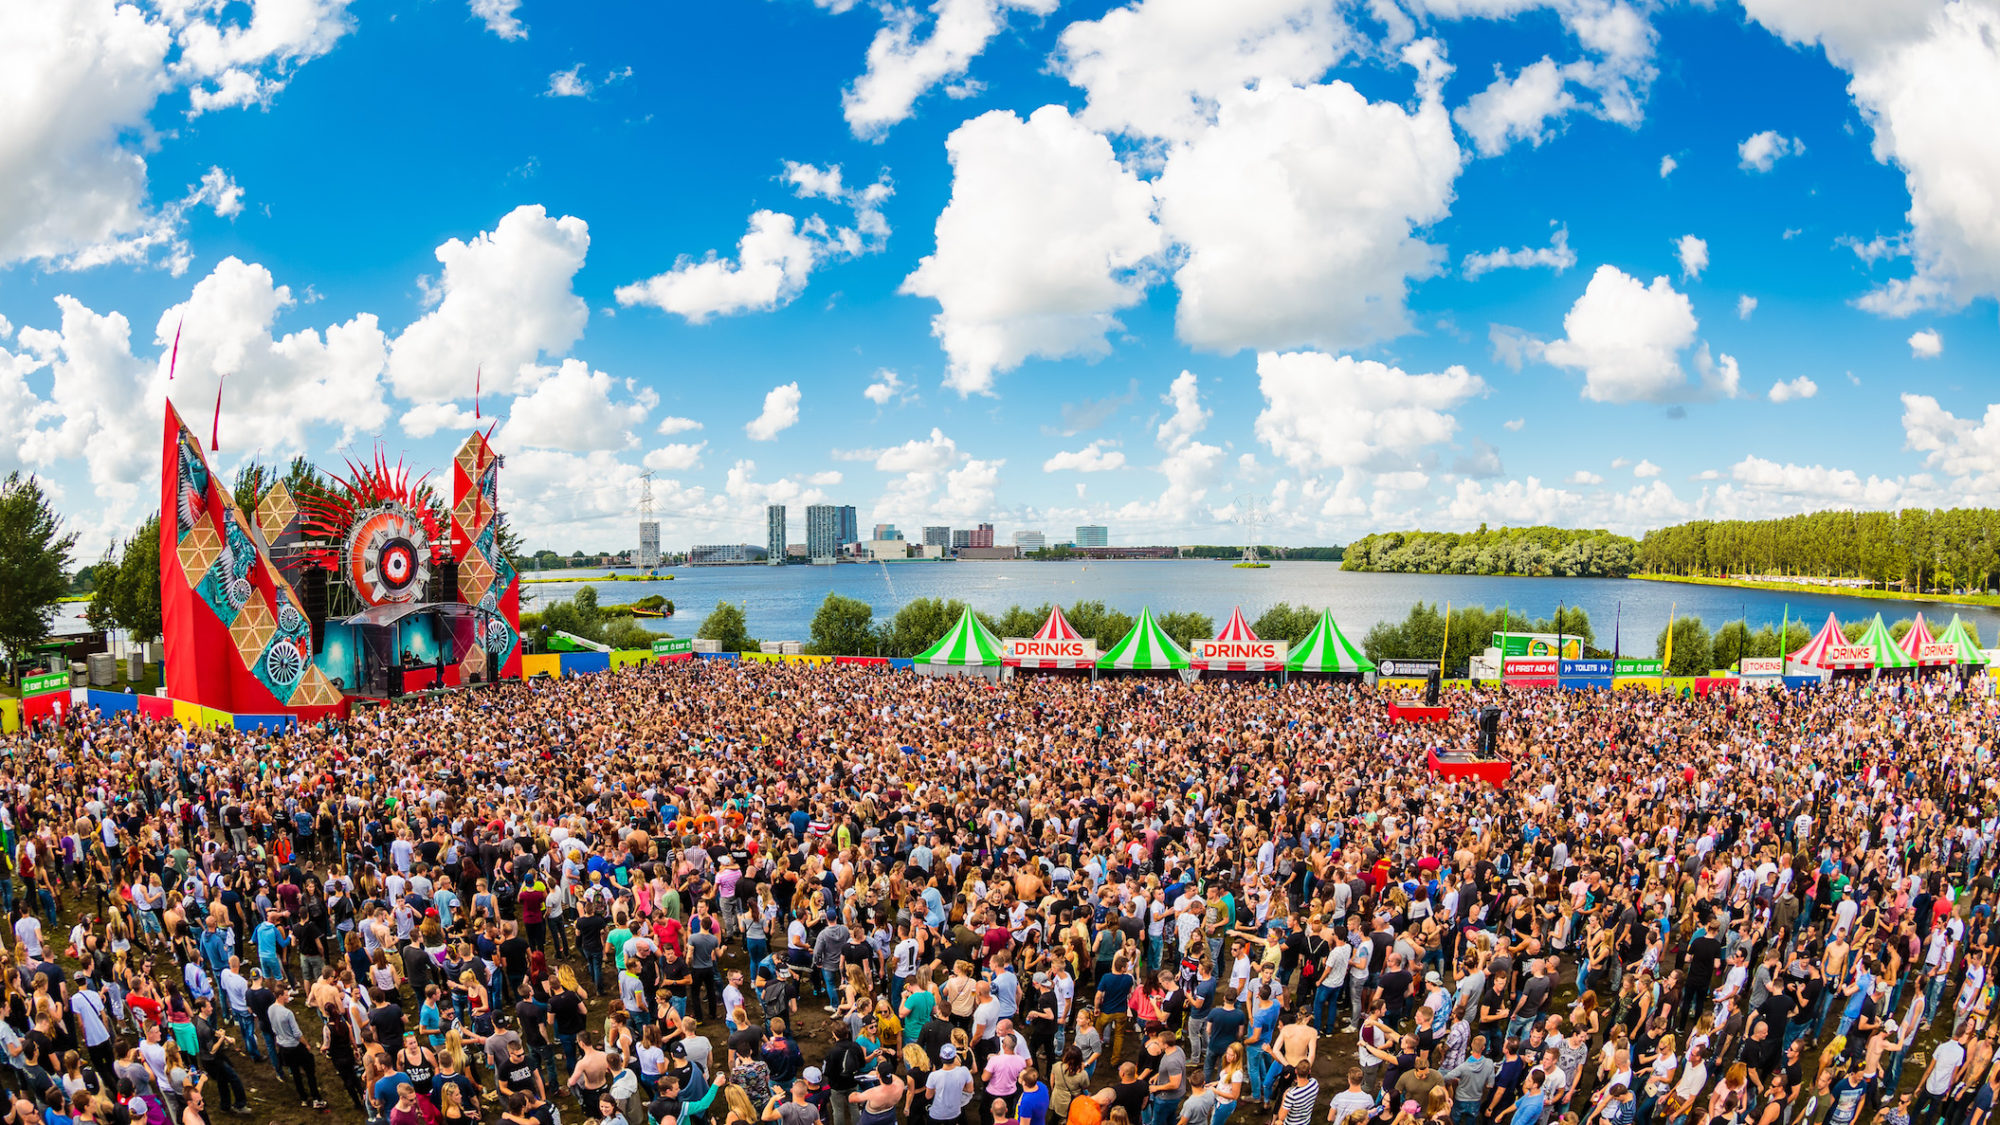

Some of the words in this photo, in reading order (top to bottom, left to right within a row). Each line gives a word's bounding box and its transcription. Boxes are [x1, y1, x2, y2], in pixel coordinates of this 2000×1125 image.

[1015, 642, 1084, 656] DRINKS
[1204, 644, 1275, 658] DRINKS
[1832, 647, 1870, 660] DRINKS
[1924, 644, 1954, 657] DRINKS
[1515, 664, 1534, 673] FIRST
[1534, 664, 1547, 672] AID
[1575, 664, 1598, 672] TOILETS
[1749, 661, 1781, 671] TOKENS
